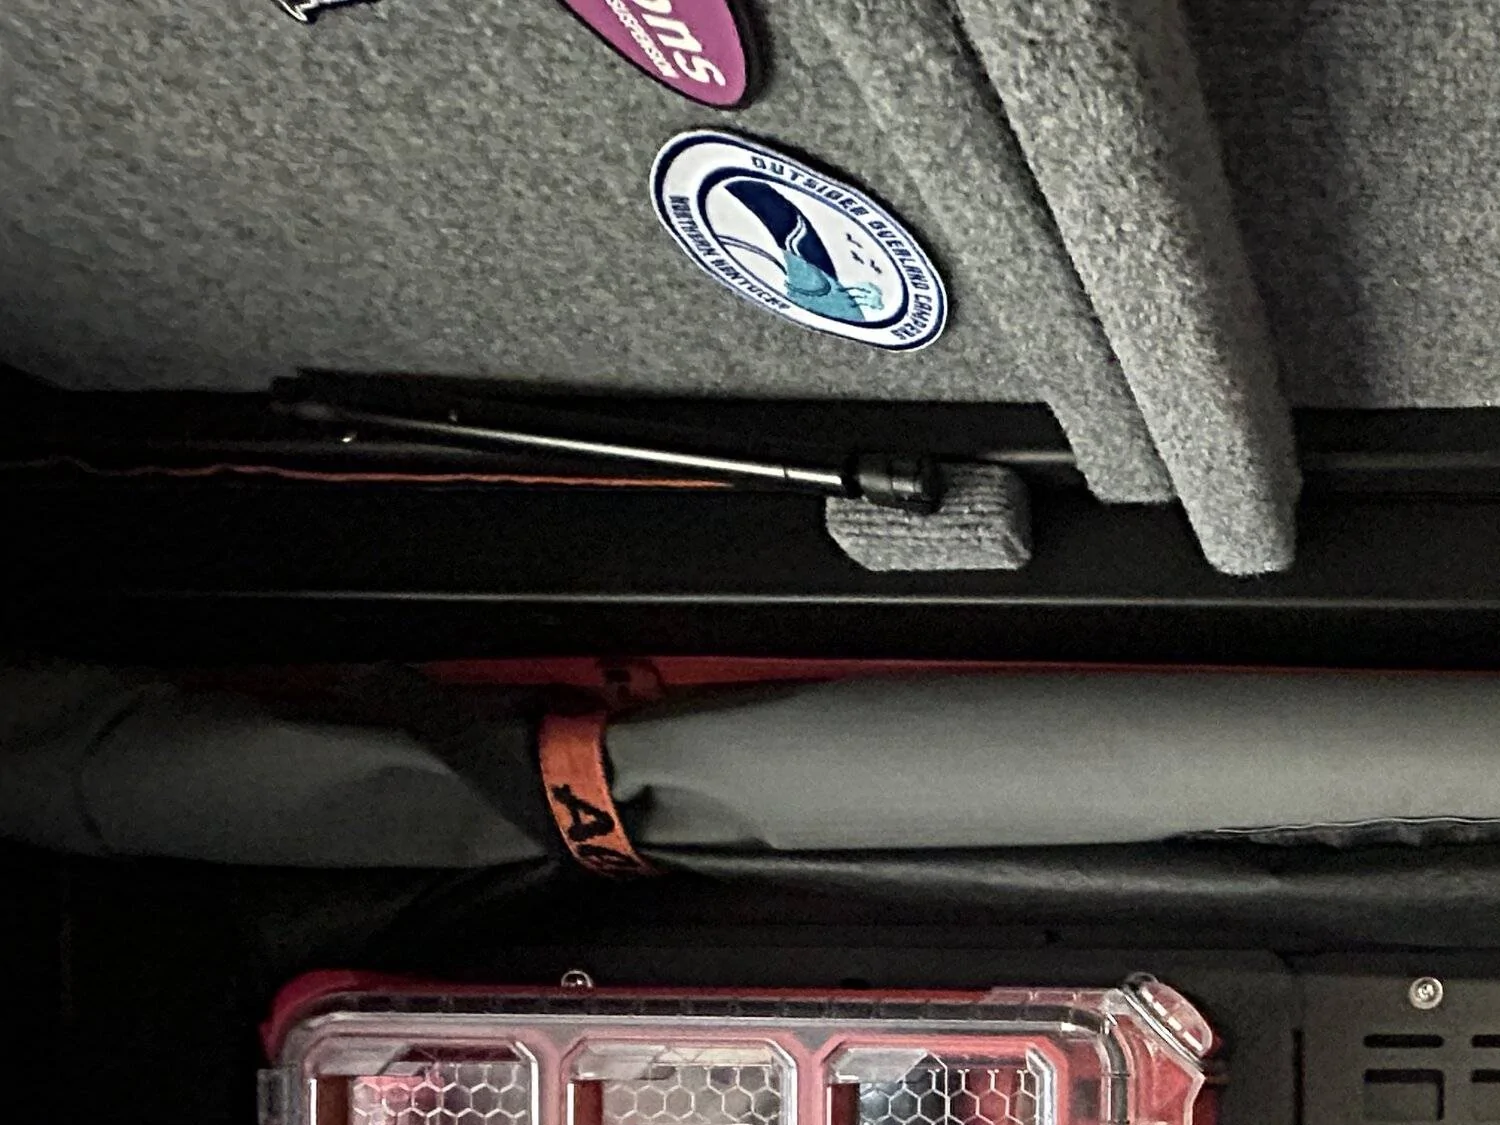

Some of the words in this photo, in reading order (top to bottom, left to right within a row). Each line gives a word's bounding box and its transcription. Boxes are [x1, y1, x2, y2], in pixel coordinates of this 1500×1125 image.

[669, 195, 721, 256] NORTHERN
[750, 155, 869, 217] OUTSIDER
[868, 221, 930, 290] OVERLAND
